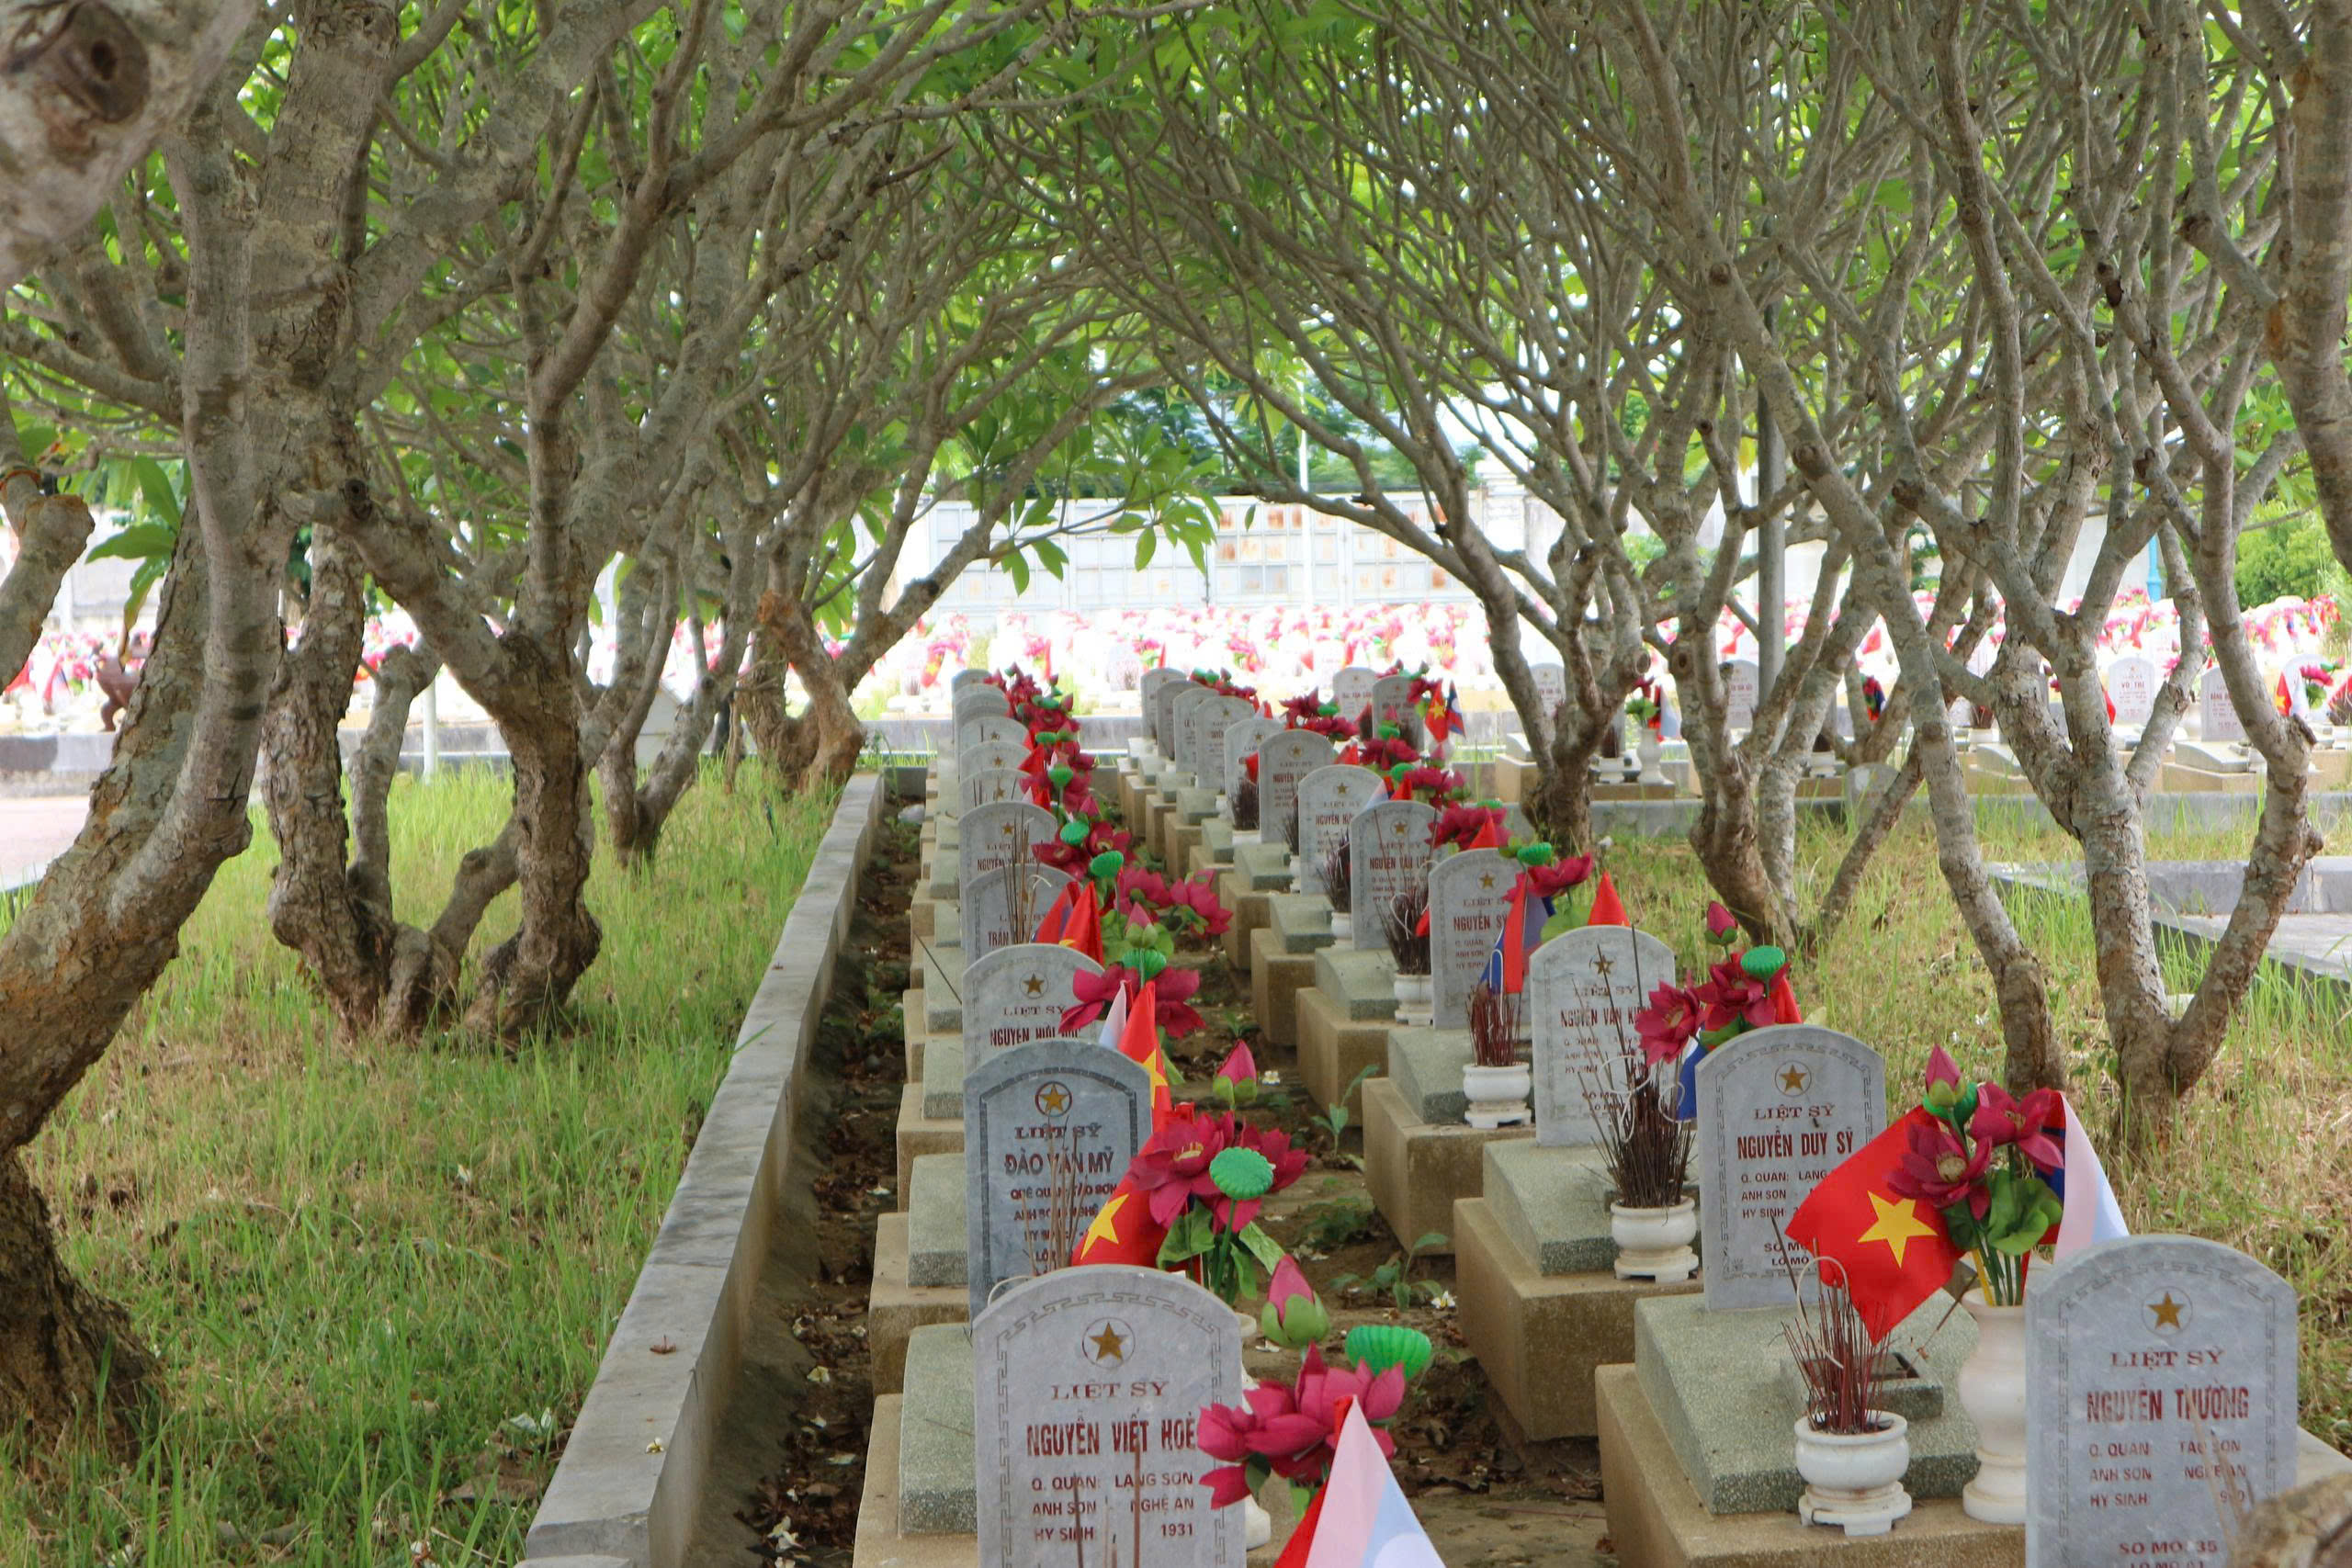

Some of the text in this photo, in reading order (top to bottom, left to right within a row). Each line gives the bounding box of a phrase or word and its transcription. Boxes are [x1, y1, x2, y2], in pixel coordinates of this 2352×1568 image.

[1801, 1132, 1827, 1156] DUY
[1742, 1190, 1763, 1201] ANH
[1742, 1208, 1757, 1219] HY
[1026, 1409, 1100, 1456] NGUYỄN
[2090, 1467, 2119, 1483] ANH
[1032, 1501, 1062, 1516] ANH
[1174, 1496, 1194, 1511] AN
[2090, 1493, 2109, 1507] HY
[1035, 1527, 1055, 1541] HY
[1160, 1523, 1193, 1537] 1931
